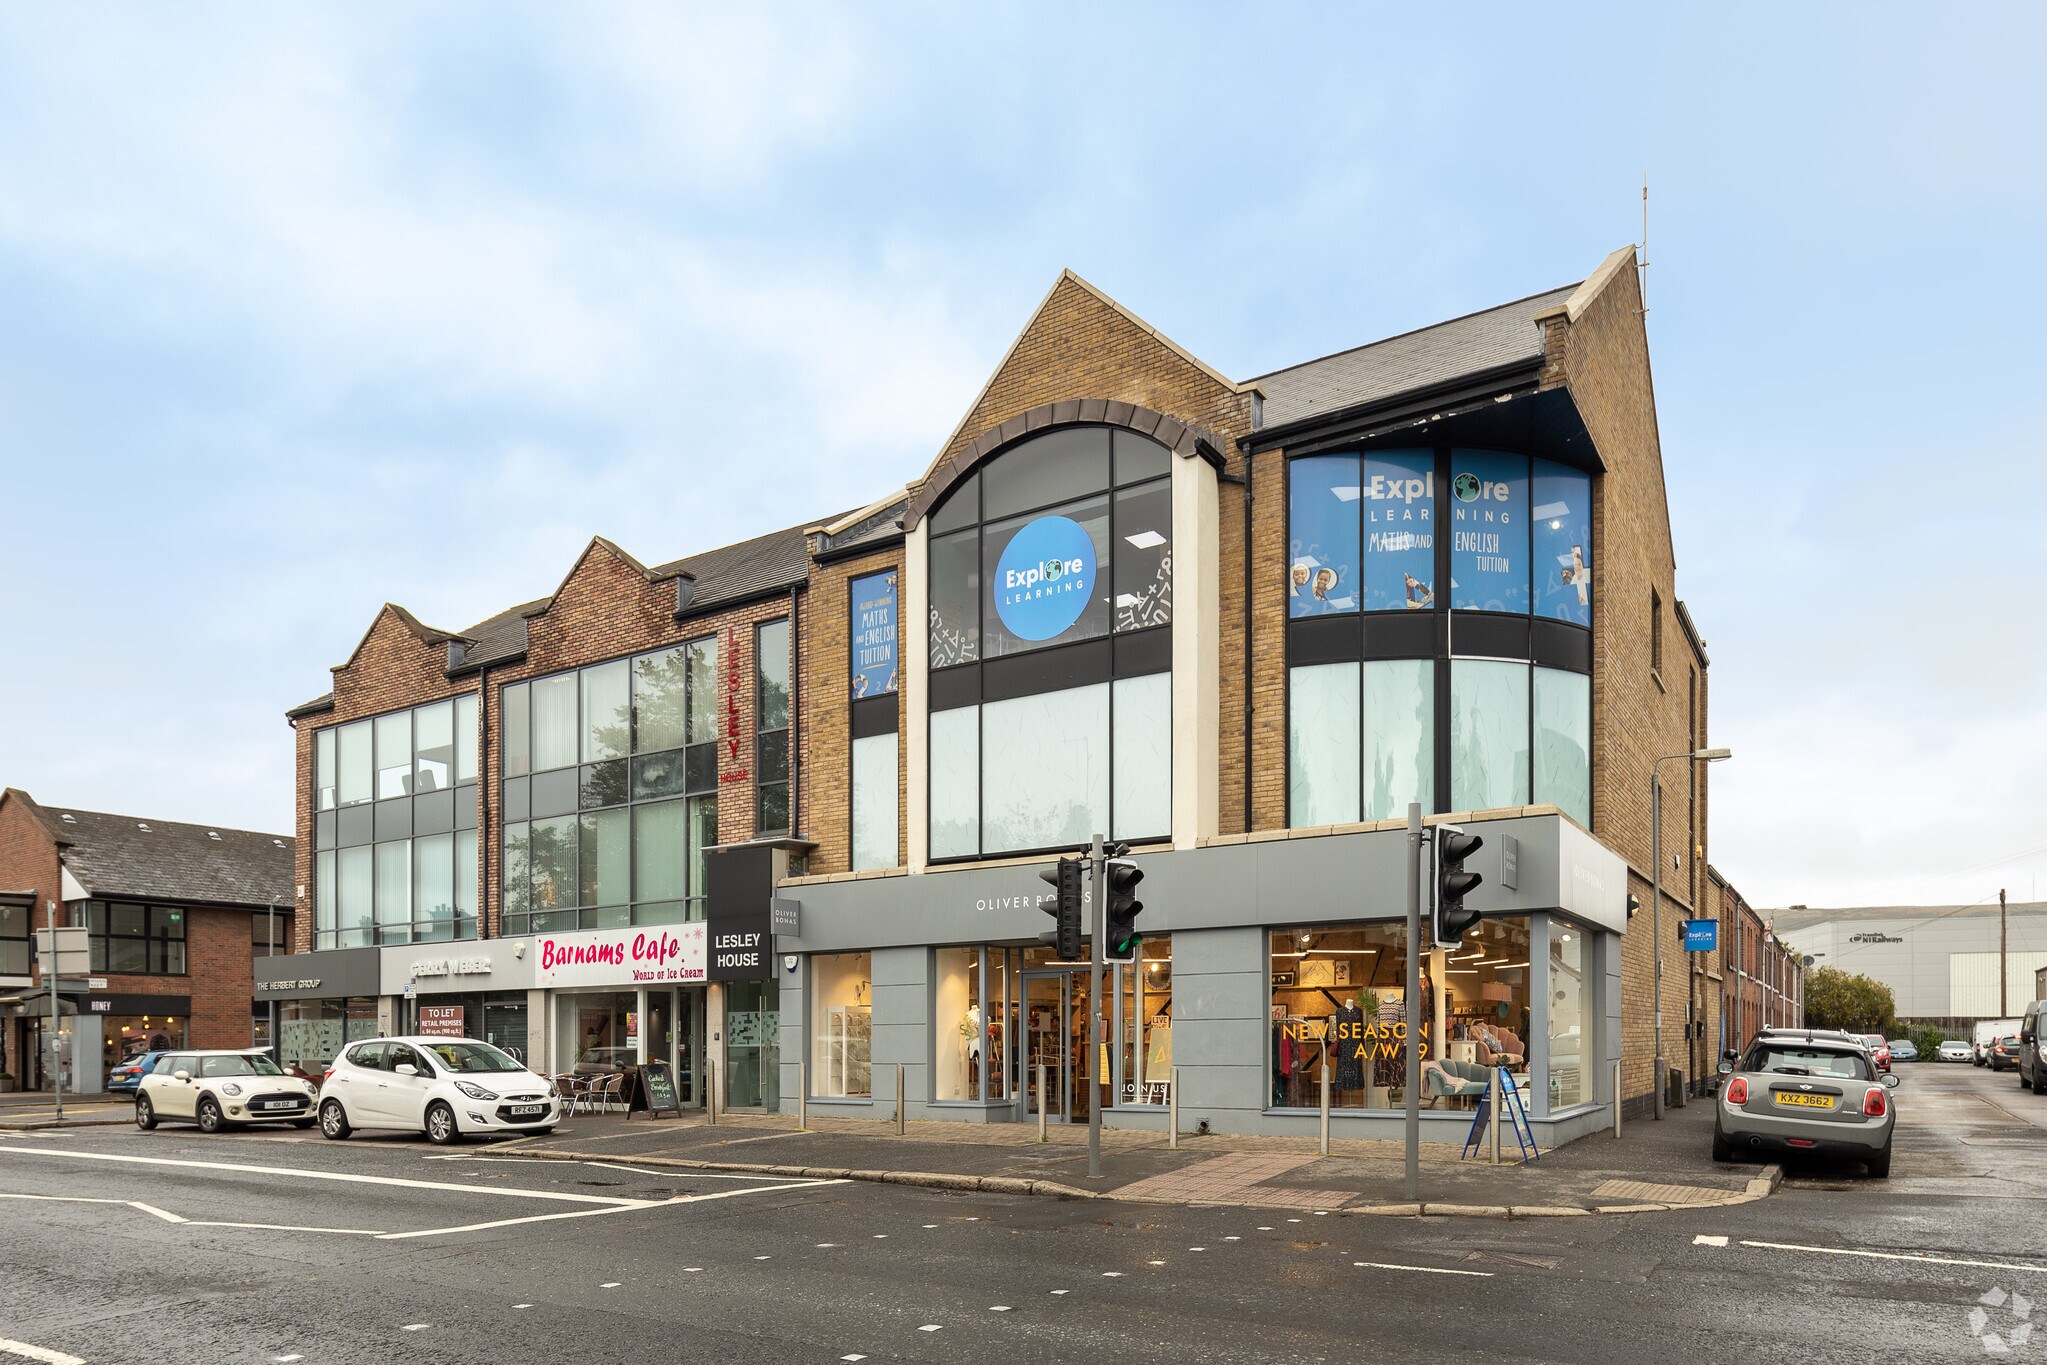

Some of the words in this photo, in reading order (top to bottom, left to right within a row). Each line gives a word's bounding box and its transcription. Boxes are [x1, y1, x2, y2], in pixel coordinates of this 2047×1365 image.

[1370, 471, 1510, 505] Explore
[1370, 508, 1510, 524] LEARNING
[1368, 531, 1411, 553] MATHS
[1414, 534, 1433, 549] AND
[1455, 531, 1499, 554] ENGLISH
[1476, 555, 1509, 573] TUITION
[1006, 558, 1083, 589] Explore
[1006, 580, 1083, 605] LEARNING
[862, 608, 888, 629] MATHS
[855, 634, 864, 644] AND
[864, 625, 895, 646] ENGLISH
[860, 644, 891, 666] TUITION
[728, 626, 740, 759] LESLEY
[720, 771, 748, 784] HOUSE
[976, 896, 1029, 911] OLIVER
[775, 909, 797, 917] OLIVER
[775, 917, 797, 925] BONAS
[715, 933, 760, 949] LESLEY
[541, 939, 625, 970] Barnams
[631, 931, 680, 966] Cafe
[410, 960, 448, 977] GERRY
[447, 958, 491, 974] WEBER
[717, 953, 759, 968] HOUSE
[257, 982, 269, 991] THE
[269, 980, 297, 990] HERBERT
[298, 979, 321, 988] GROUP
[91, 1001, 111, 1011] HONEY
[428, 1009, 440, 1018] TO
[441, 1008, 455, 1018] LET
[439, 1019, 462, 1027] PREMISES
[1152, 1016, 1168, 1024] LIVE
[1282, 1022, 1329, 1040] NEW
[1353, 1043, 1428, 1061] A/W9
[1153, 1083, 1165, 1093] US
[1780, 1093, 1801, 1103] KXZ
[1803, 1096, 1829, 1106] 3662
[515, 1106, 527, 1114] RFZ
[527, 1105, 540, 1113] 4571
